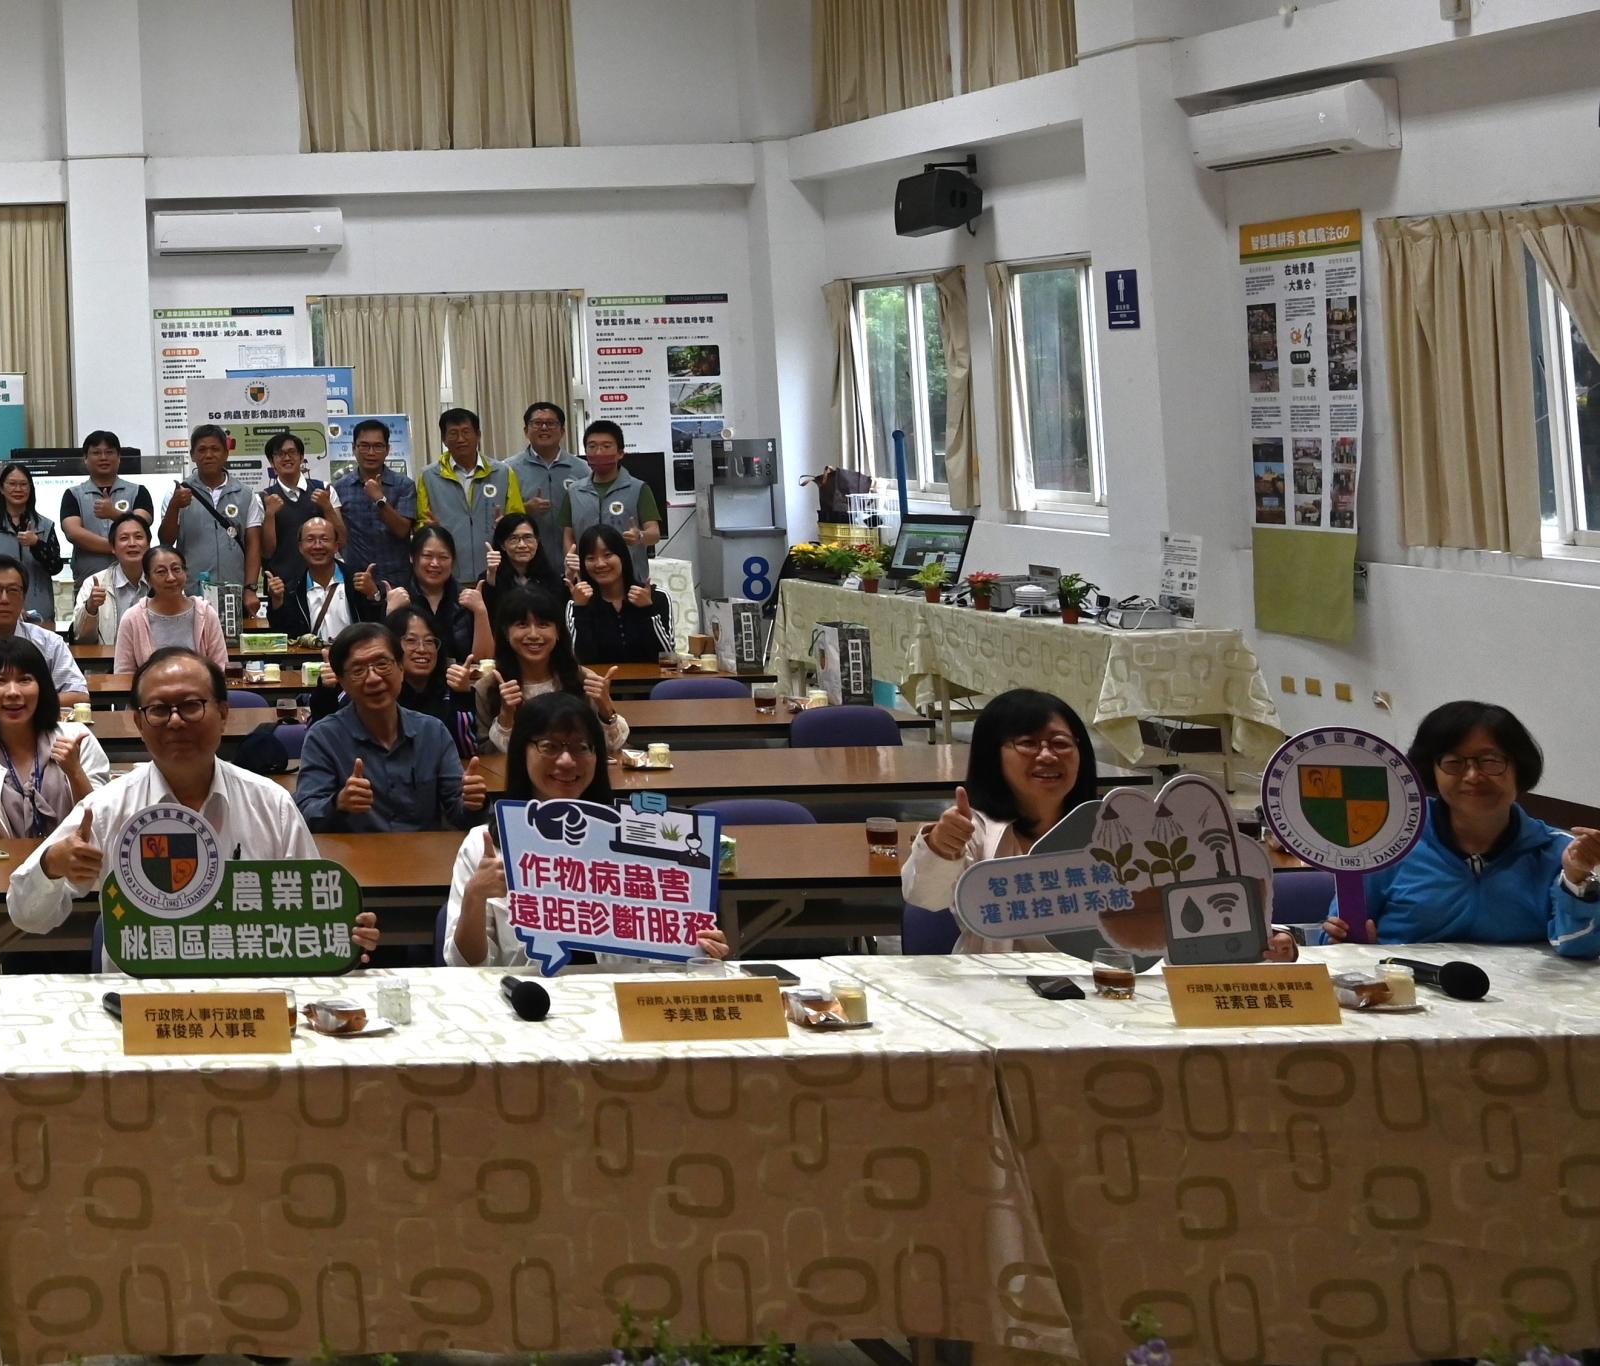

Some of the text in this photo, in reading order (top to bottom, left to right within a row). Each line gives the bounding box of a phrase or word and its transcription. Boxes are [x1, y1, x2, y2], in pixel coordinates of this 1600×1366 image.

[1284, 262, 1315, 276] 在地青農
[1288, 278, 1311, 291] 大集合
[208, 412, 222, 420] 5G
[742, 556, 772, 600] 8
[1269, 800, 1325, 863] Taoyuan
[1404, 806, 1420, 836] MOA
[1339, 857, 1361, 867] 1982
[518, 852, 690, 903] 作物病蟲害
[988, 863, 1114, 897] 智慧型無線
[232, 870, 343, 912] 農業部
[979, 887, 1133, 925] 灌溉控制系統
[508, 892, 717, 946] 遠距診斷服務
[120, 922, 351, 961] 桃園區農業改良場
[144, 1007, 266, 1022] 行政院人事行政總處
[664, 1006, 742, 1022] 李美惠 處長
[1213, 994, 1294, 1010] 莊素宜 處長
[156, 1022, 257, 1039] 蘇俊榮 人事長
